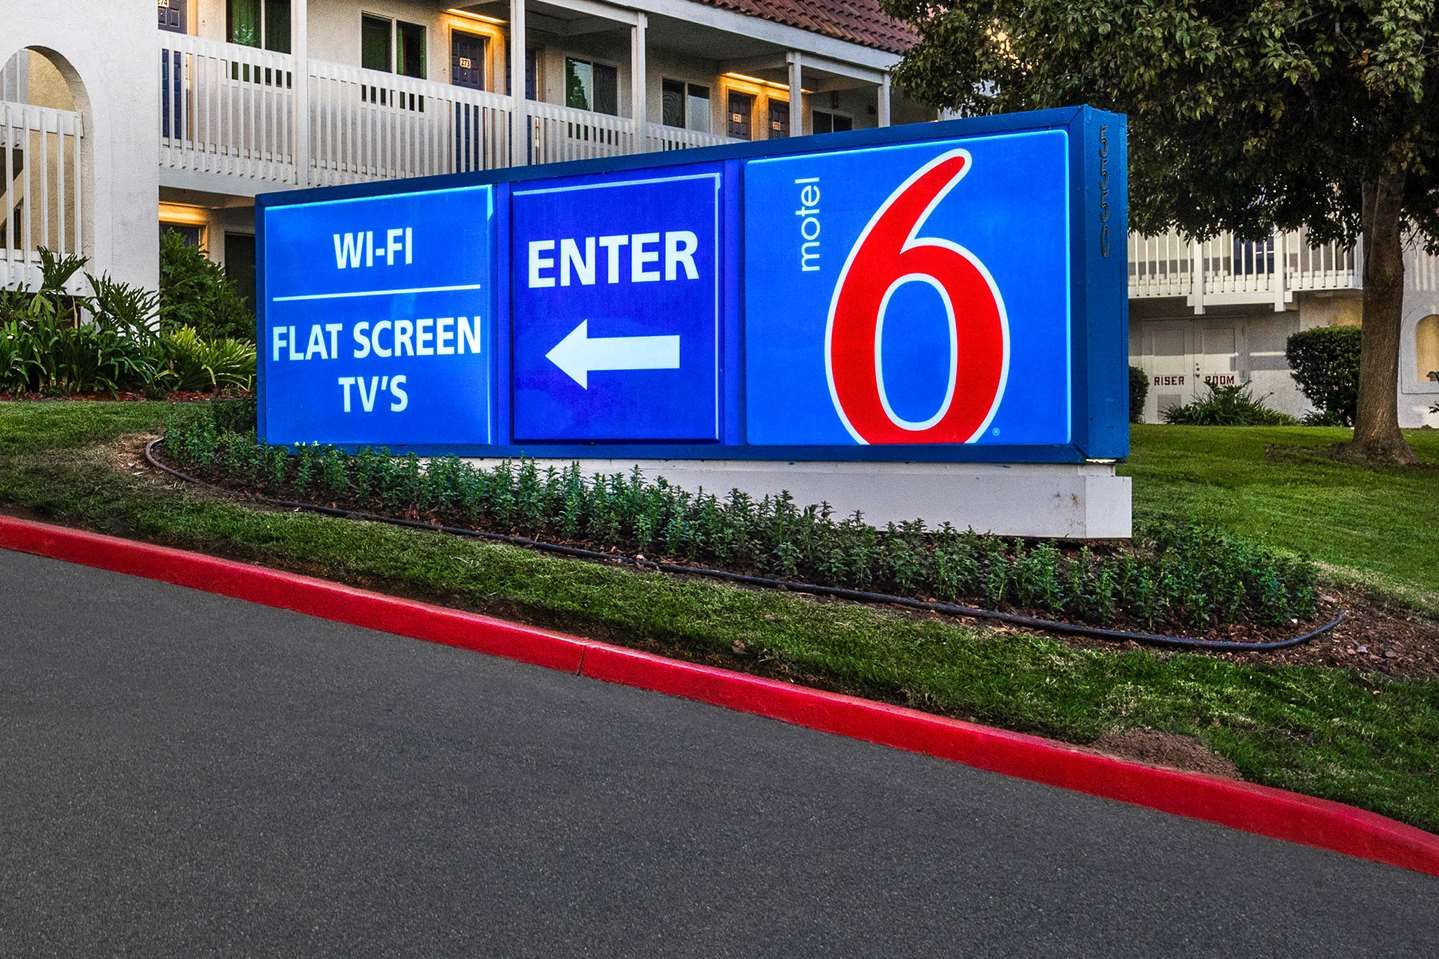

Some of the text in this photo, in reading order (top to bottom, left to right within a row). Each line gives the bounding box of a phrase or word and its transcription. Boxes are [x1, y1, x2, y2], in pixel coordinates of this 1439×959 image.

[794, 176, 821, 272] motel
[333, 227, 413, 270] WI-FI
[528, 230, 700, 289] ENTER
[824, 146, 1012, 445] 6
[272, 315, 481, 361] FLAT SCREEN
[338, 374, 409, 413] TV'S
[1154, 375, 1185, 386] RISER
